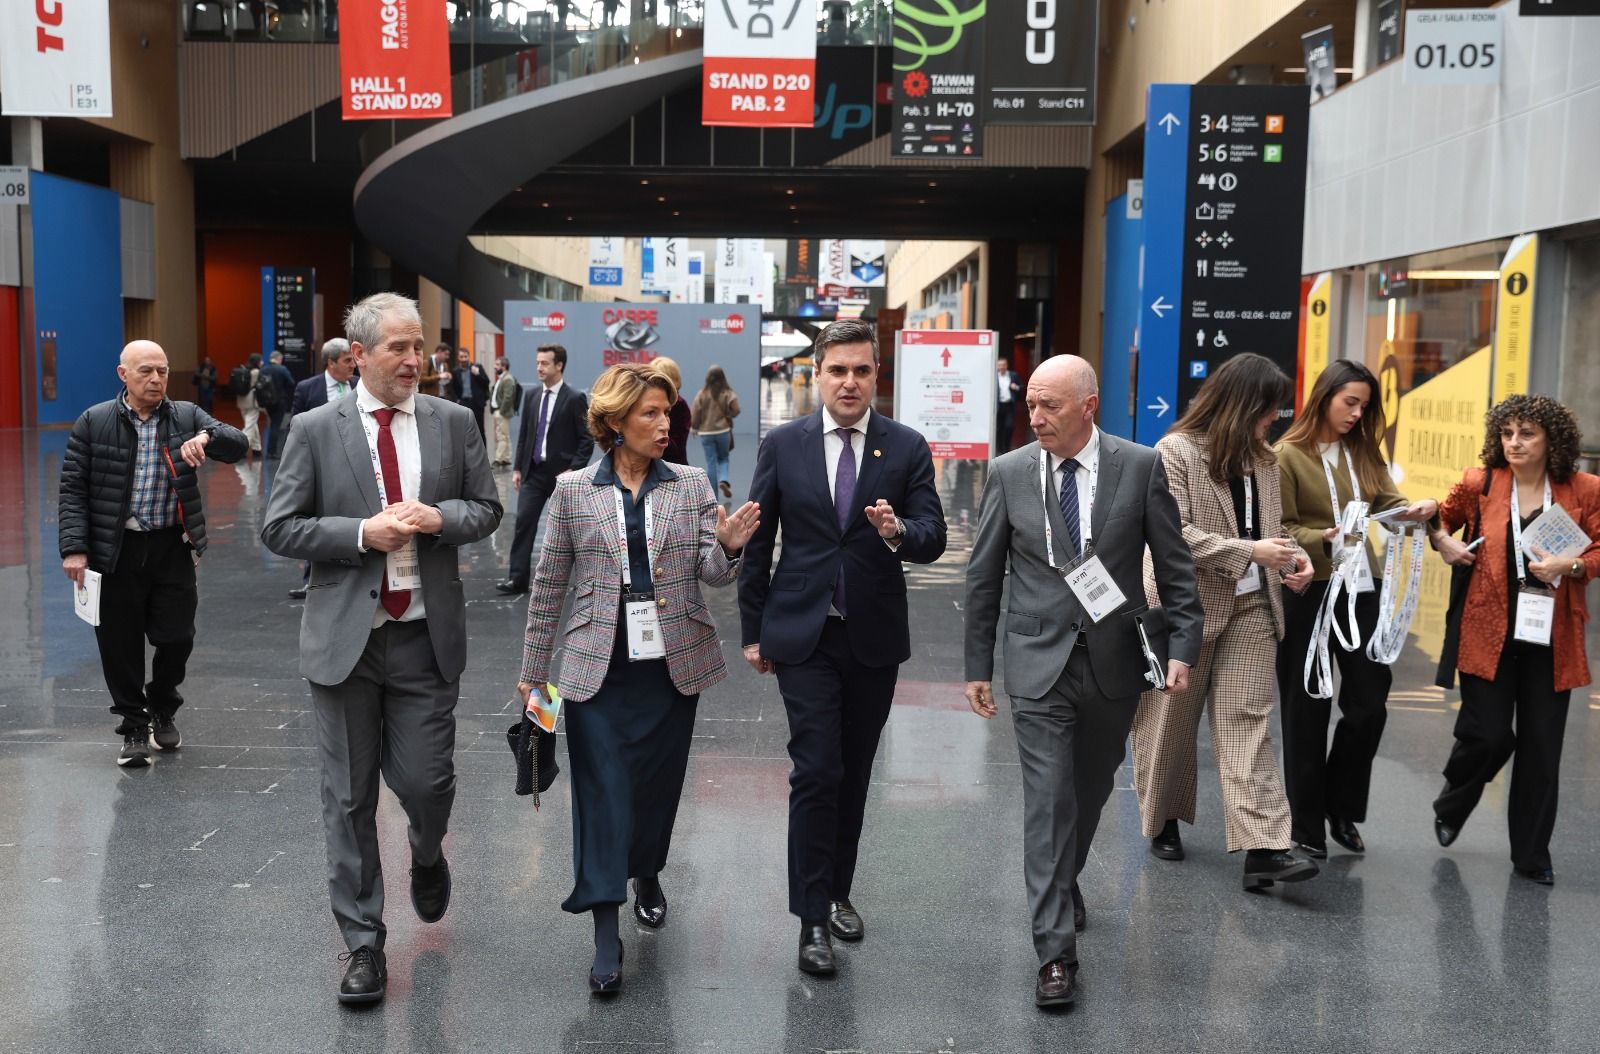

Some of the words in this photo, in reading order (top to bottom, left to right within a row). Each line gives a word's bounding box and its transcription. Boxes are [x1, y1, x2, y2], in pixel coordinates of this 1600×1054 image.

[1415, 43, 1496, 69] 01.05
[350, 77, 395, 93] HALL
[397, 76, 406, 92] 1
[709, 73, 768, 89] STAND
[773, 75, 810, 90] D20
[931, 75, 975, 88] TAIWAN
[77, 85, 93, 95] P5
[931, 87, 975, 95] EXCELLENCE
[77, 98, 98, 108] E31
[351, 94, 408, 110] STAND
[410, 92, 442, 109] D29
[731, 95, 772, 111] PAB.
[774, 96, 786, 111] 2
[1039, 98, 1064, 108] Stand
[1065, 98, 1086, 109] C11
[903, 106, 922, 116] Pab.
[936, 102, 975, 117] H-70
[1213, 310, 1236, 319] 02.05
[1241, 310, 1264, 319] 02.06
[1269, 311, 1292, 320] 02.07
